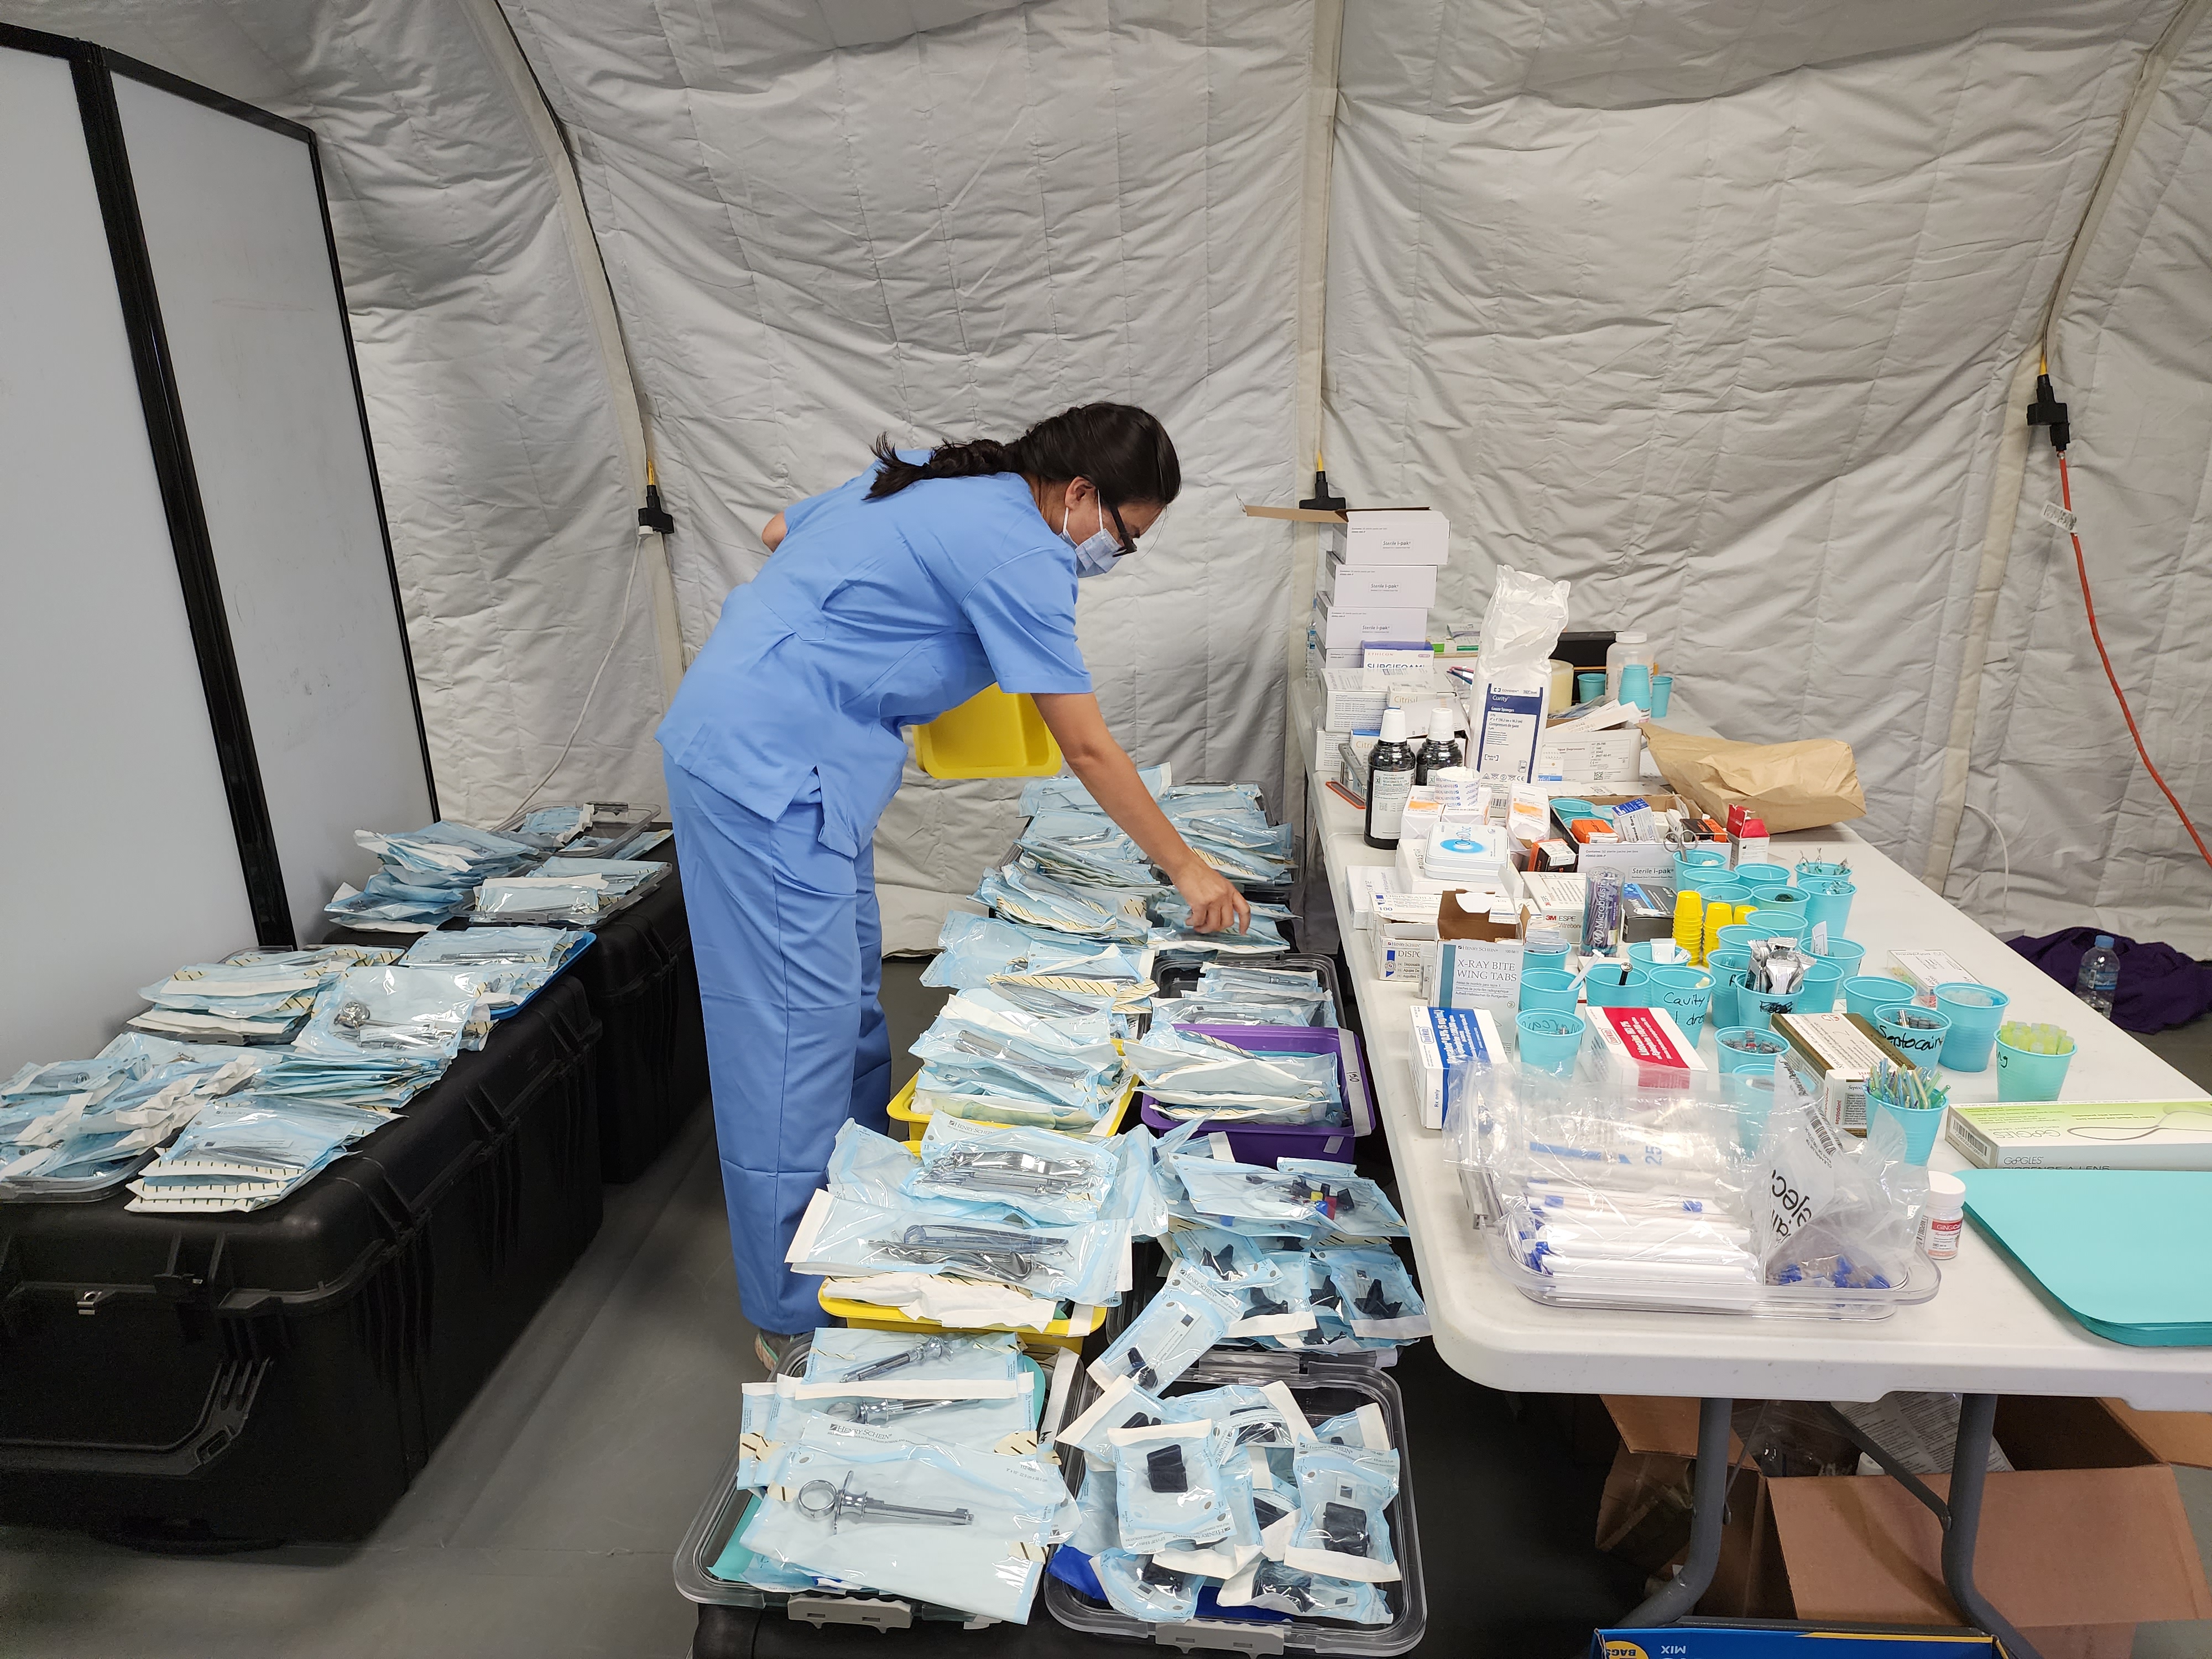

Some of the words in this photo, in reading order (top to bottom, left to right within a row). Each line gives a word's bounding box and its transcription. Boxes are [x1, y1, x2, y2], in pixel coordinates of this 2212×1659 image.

[1595, 881, 1606, 928] Microbrush
[1457, 959, 1490, 968] X-RAY
[1492, 962, 1515, 971] BITE
[1457, 969, 1488, 979] WING
[1490, 972, 1517, 982] TABS
[1663, 992, 1705, 1008] Cavity
[1631, 1035, 1650, 1056] Lidocaine
[954, 1122, 974, 1132] HENRY
[1645, 1145, 1662, 1166] 25
[1185, 1272, 1201, 1286] HENRY
[1199, 1282, 1215, 1298] SCHEIN
[837, 1425, 863, 1434] HENRY
[863, 1430, 889, 1439] SCHEIN
[1217, 1436, 1231, 1457] HENRY
[1328, 1445, 1352, 1454] SCHEIN
[1202, 1528, 1224, 1538] HENRY
[1661, 1645, 1686, 1654] MIX
